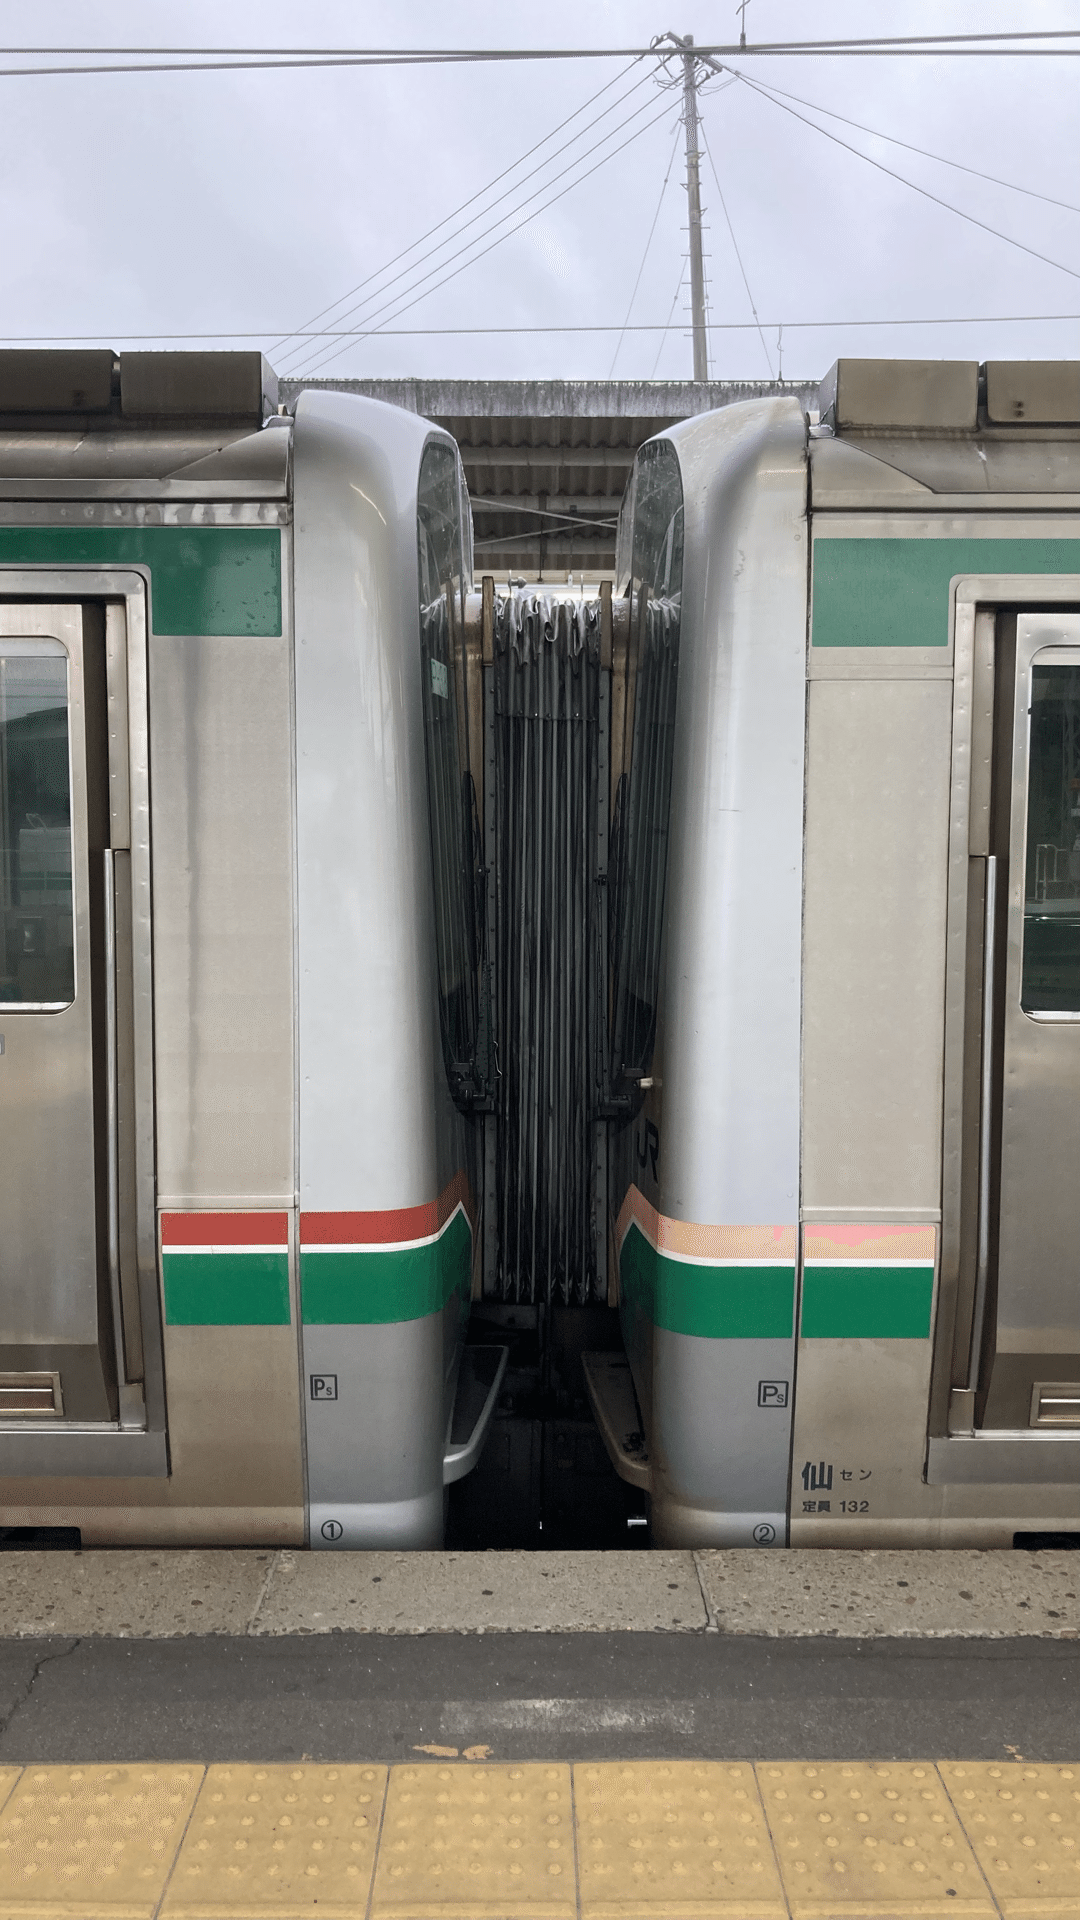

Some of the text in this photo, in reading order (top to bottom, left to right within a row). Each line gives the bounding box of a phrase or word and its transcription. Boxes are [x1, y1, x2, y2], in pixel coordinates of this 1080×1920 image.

[313, 1378, 333, 1397] Ps
[762, 1385, 785, 1404] Ps
[801, 1461, 872, 1491] 仙 セン
[802, 1500, 870, 1513] 定員 132
